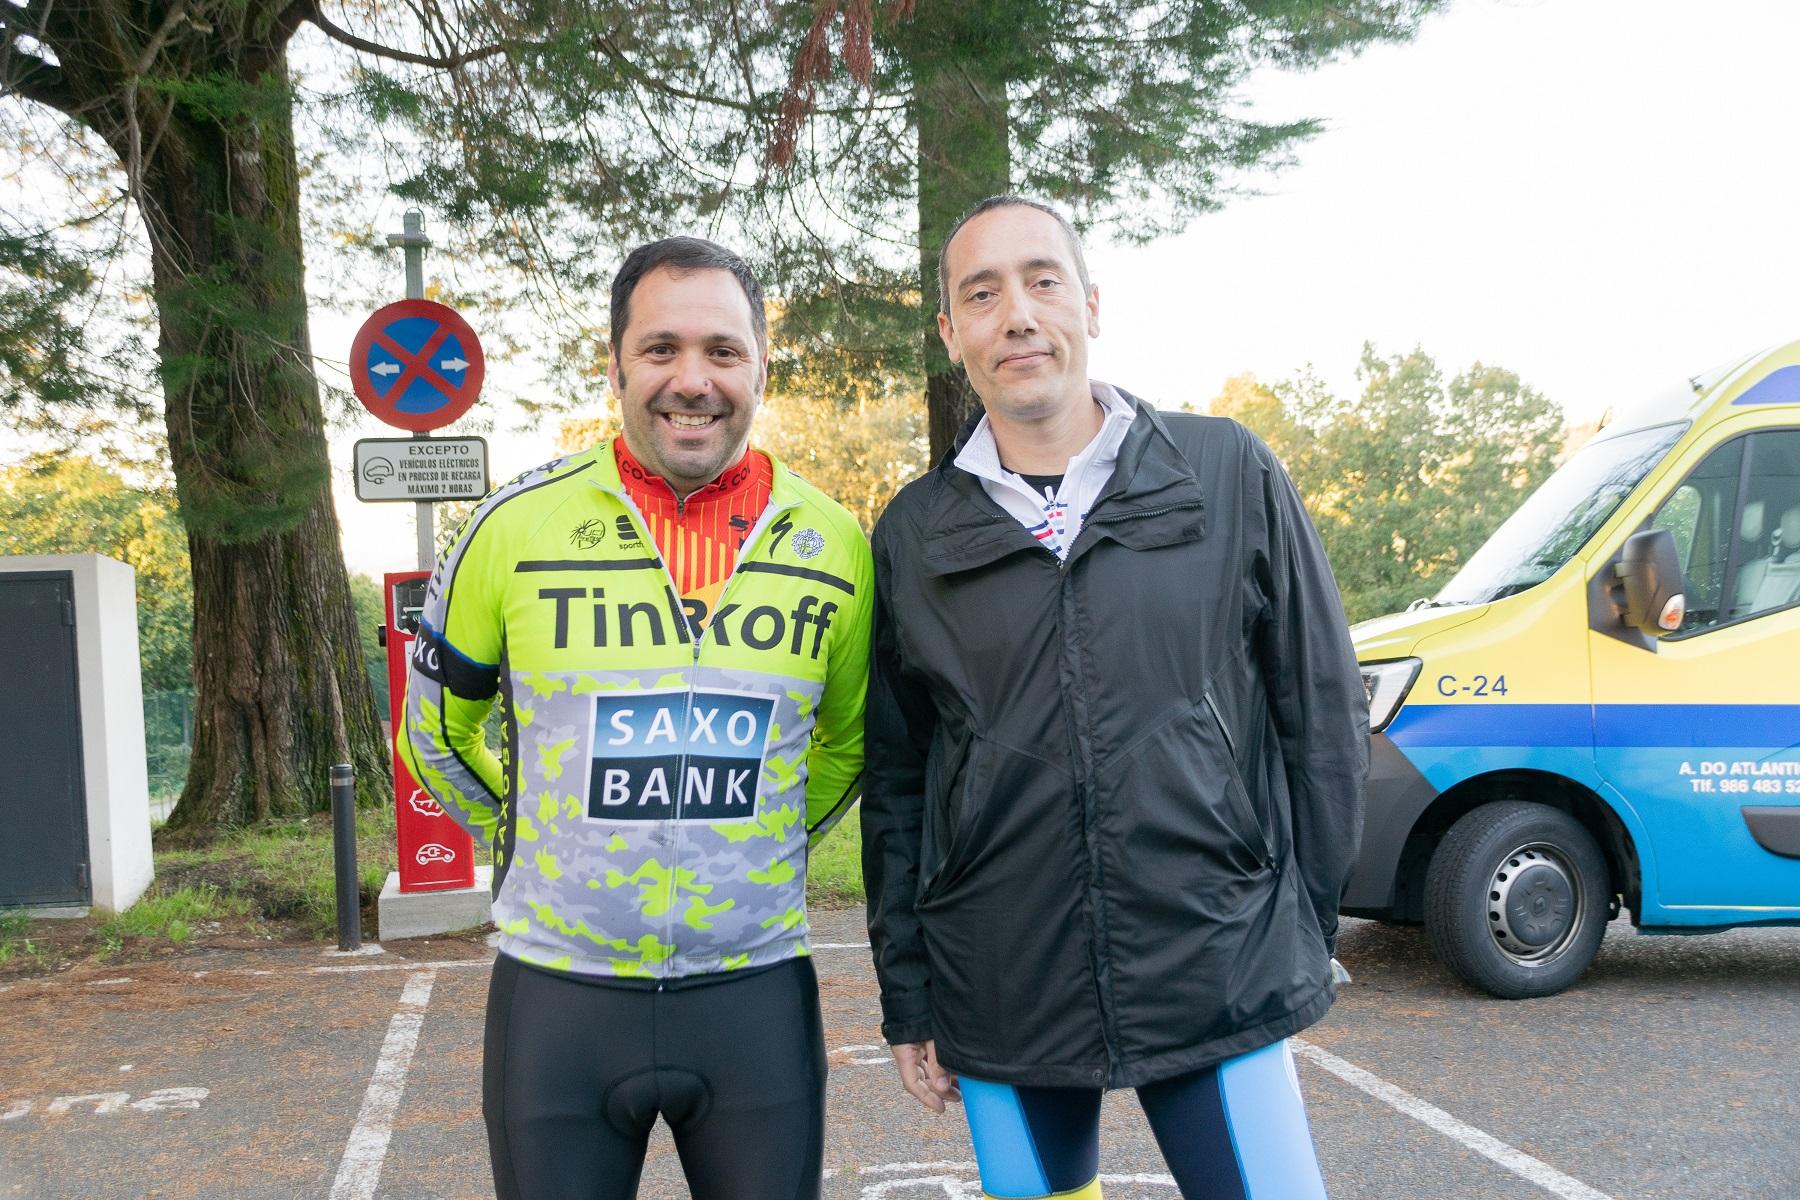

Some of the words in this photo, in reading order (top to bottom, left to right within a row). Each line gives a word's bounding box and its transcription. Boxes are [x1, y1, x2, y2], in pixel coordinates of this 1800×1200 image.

[409, 445, 469, 455] EXCEPTO
[399, 458, 437, 469] VEHÍCULOS
[439, 457, 480, 469] ELÉCTRICOS
[398, 472, 407, 482] EN
[409, 471, 439, 482] PROCESO
[441, 471, 449, 481] DE
[451, 470, 482, 481] RECARGA
[442, 484, 447, 494] 2
[449, 483, 473, 493] HORAS
[538, 585, 838, 659] Tinkoff
[1437, 675, 1509, 697] C-24
[608, 707, 757, 747] SAXO
[1679, 761, 1697, 775] A.
[1700, 761, 1727, 775] DO
[602, 767, 751, 806] BANK
[1720, 779, 1749, 793] 986
[1752, 779, 1781, 793] 483
